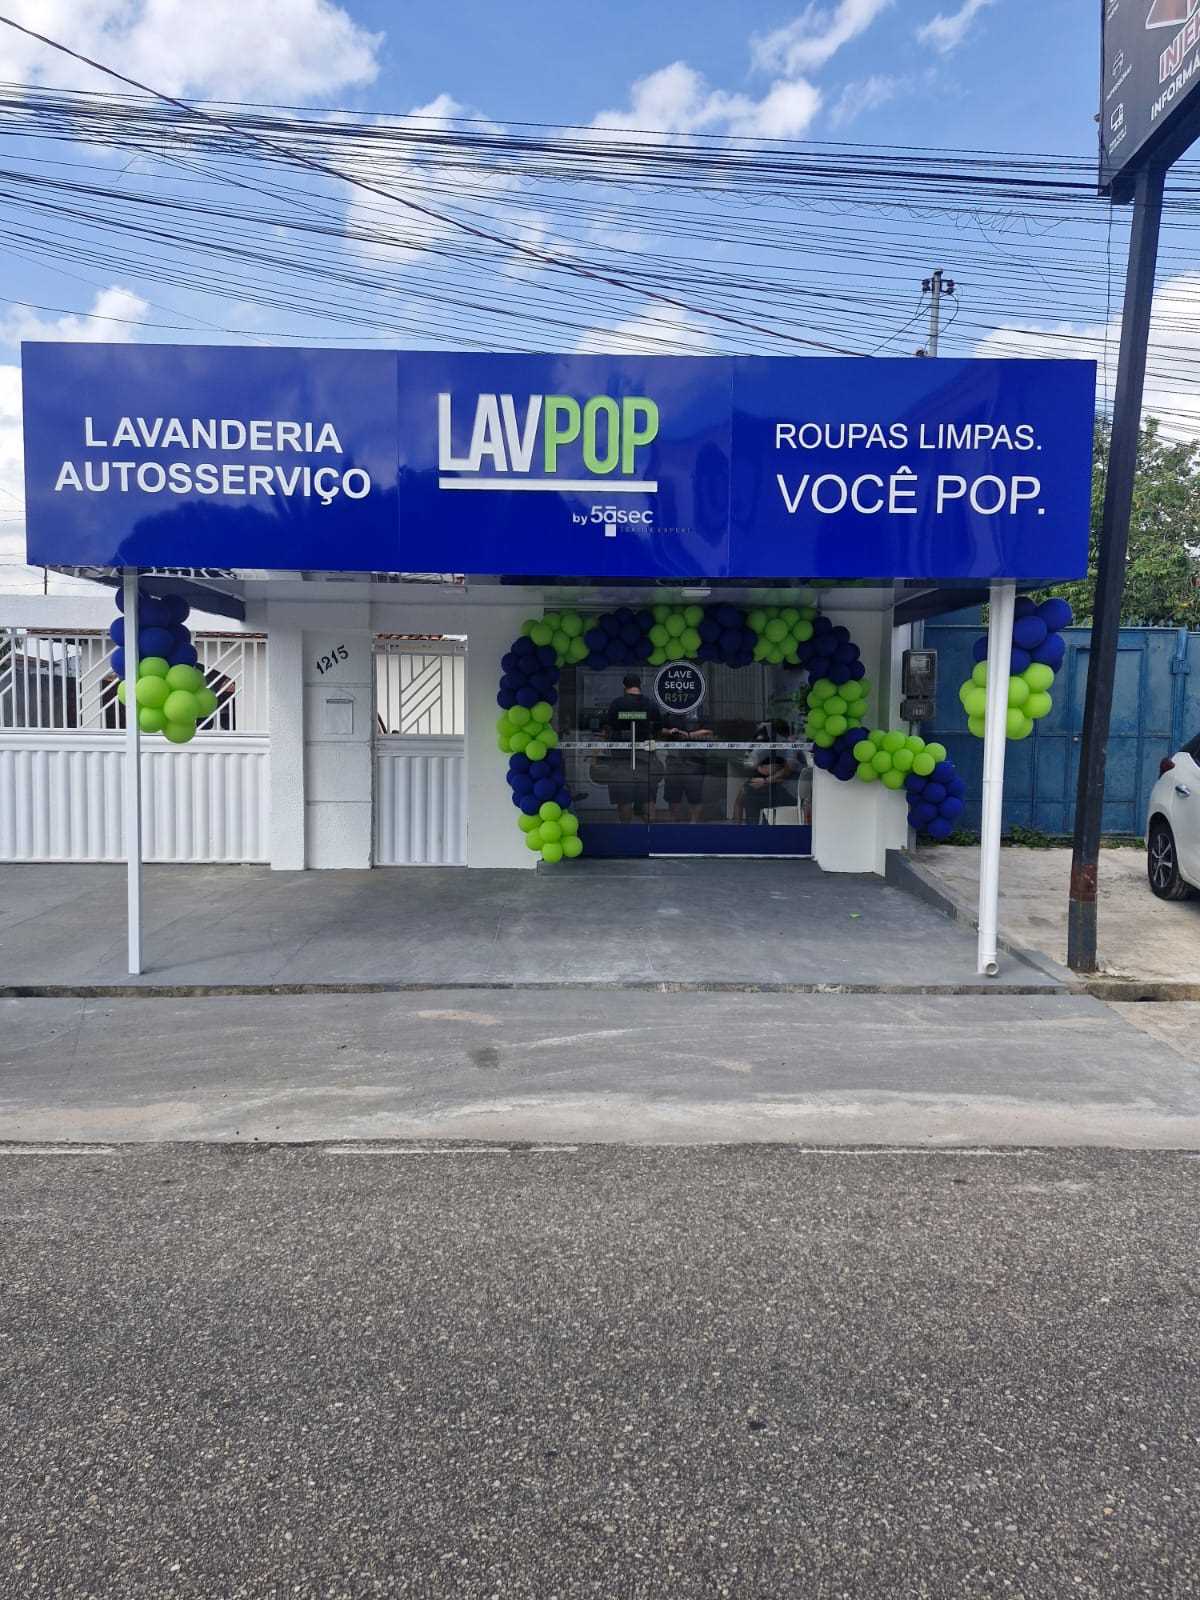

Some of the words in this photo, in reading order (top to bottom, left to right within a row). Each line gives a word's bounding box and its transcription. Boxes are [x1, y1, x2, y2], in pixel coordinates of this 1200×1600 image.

[84, 416, 344, 454] LAVANDERIA
[438, 393, 659, 475] LAVPOP
[776, 422, 909, 450] ROUPAS
[919, 422, 1043, 451] LIMPAS.
[54, 460, 372, 505] AUTOSSERVIÇO
[776, 464, 919, 515] VOCÊ
[936, 474, 1046, 516] POP.
[572, 513, 588, 526] by
[316, 643, 349, 675] 1215
[668, 670, 693, 679] LAVE
[664, 680, 696, 690] SEQUE
